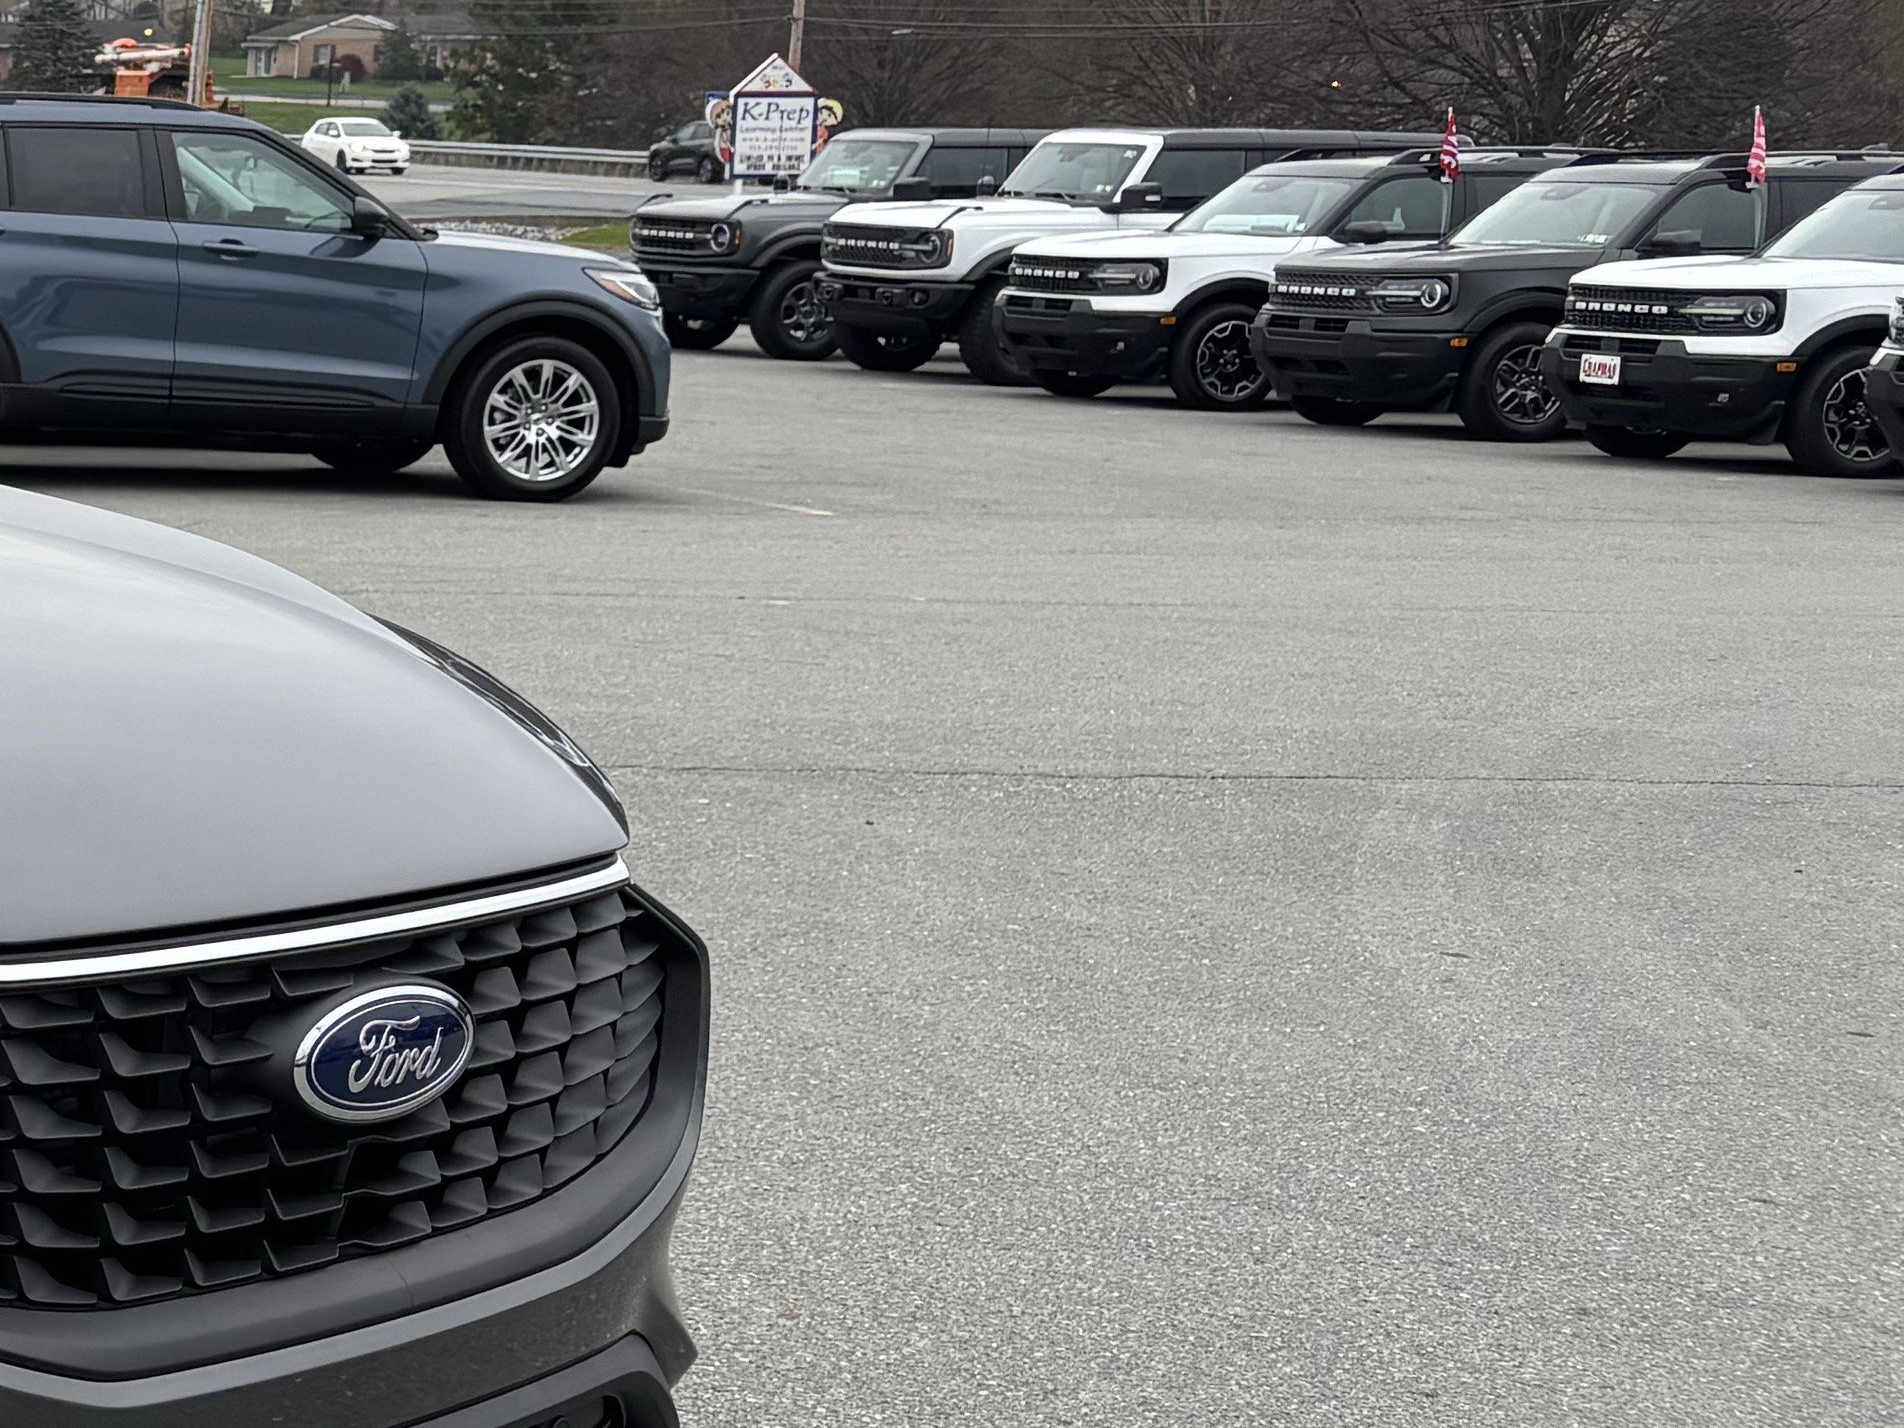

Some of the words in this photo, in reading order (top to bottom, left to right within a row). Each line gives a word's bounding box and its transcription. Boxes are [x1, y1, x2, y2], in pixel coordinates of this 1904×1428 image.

[741, 102, 810, 124] K-Prep
[1015, 267, 1080, 279] BRONCO
[1277, 285, 1356, 297] BRONCO
[1574, 301, 1669, 315] BRONCO
[348, 1014, 444, 1094] Ford
